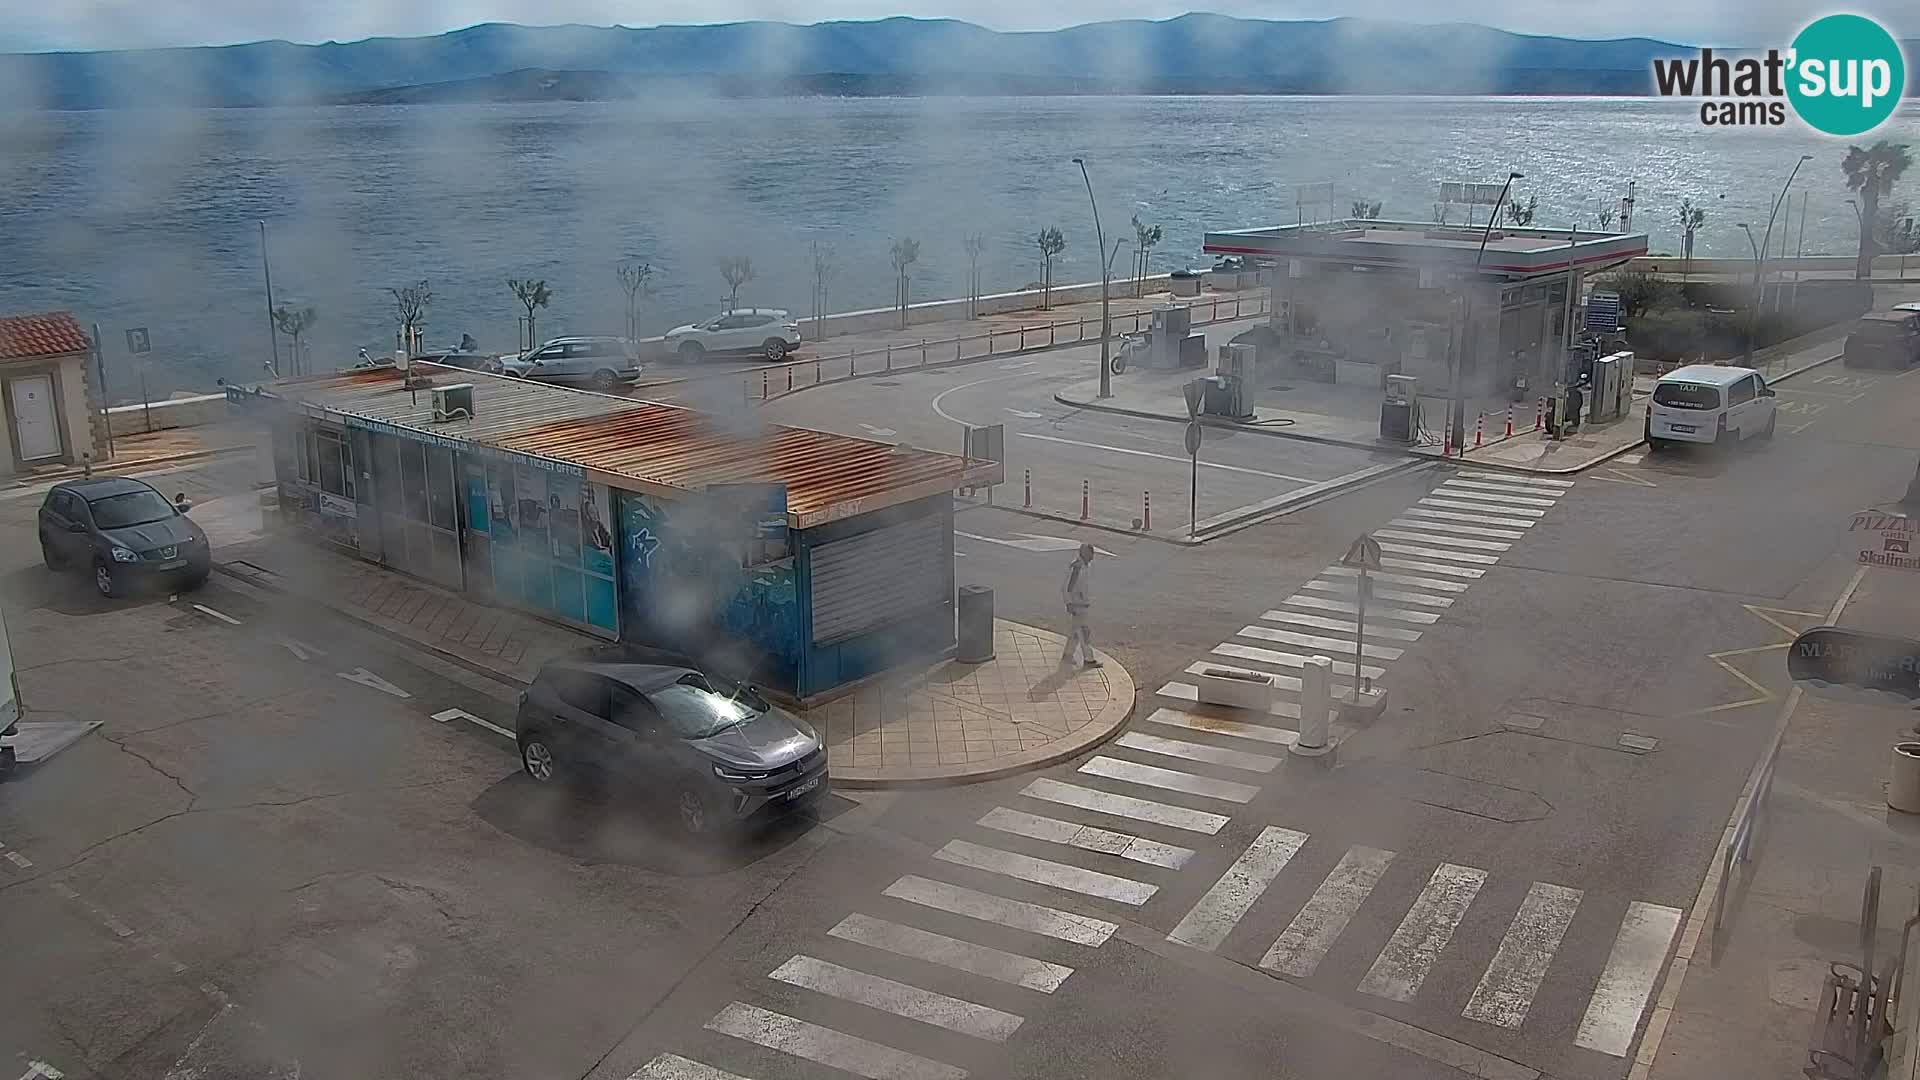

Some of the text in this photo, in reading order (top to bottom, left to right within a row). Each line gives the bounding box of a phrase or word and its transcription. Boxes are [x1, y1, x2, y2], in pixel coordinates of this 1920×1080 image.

[1679, 384, 1698, 393] TAXI
[529, 456, 555, 471] TICKET
[557, 462, 583, 477] OFFICE
